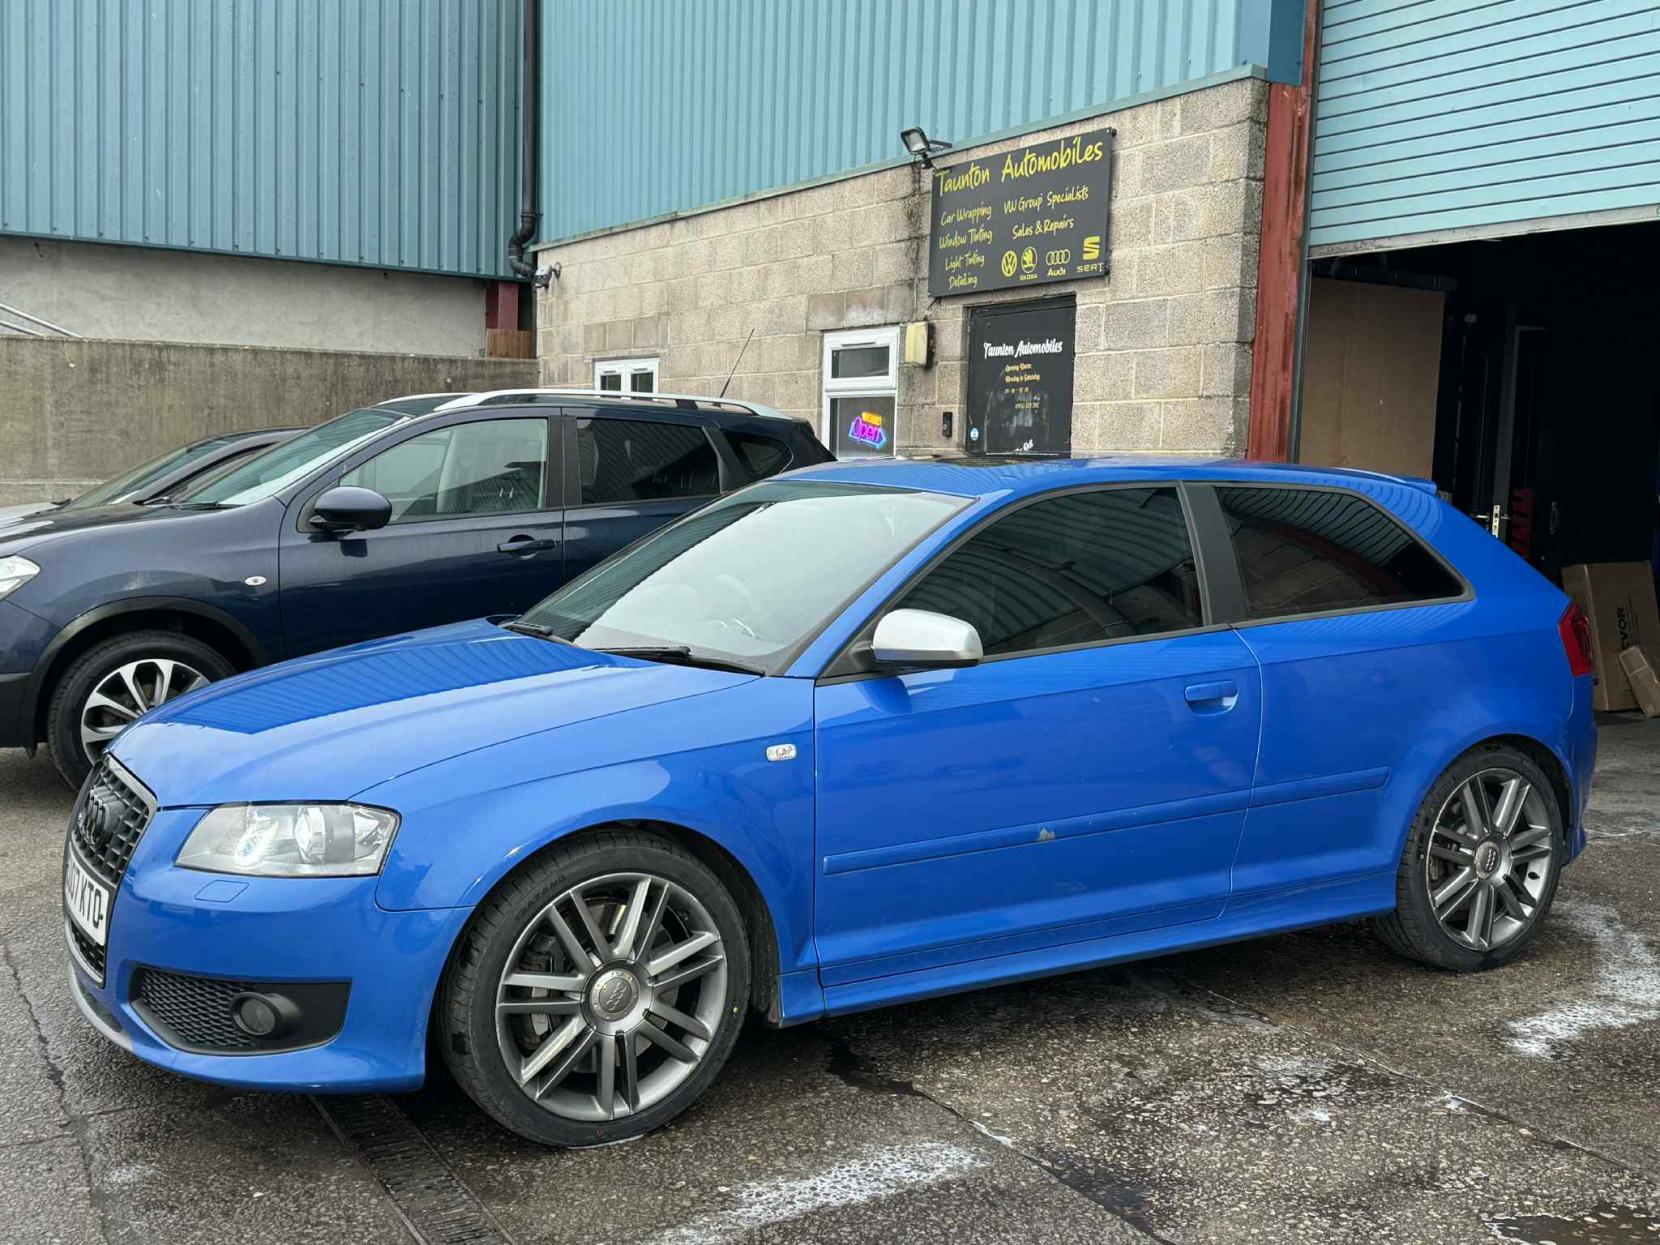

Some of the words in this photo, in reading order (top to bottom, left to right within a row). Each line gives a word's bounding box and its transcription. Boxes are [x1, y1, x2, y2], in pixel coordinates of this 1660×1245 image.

[935, 162, 990, 197] Taunton
[1001, 136, 1103, 183] Automobiles
[1018, 194, 1043, 213] Group
[1046, 184, 1089, 210] Specialists
[941, 211, 956, 226] Car
[956, 201, 992, 223] Wrapping
[939, 229, 967, 249] Window
[968, 223, 993, 245] Tinting
[1012, 223, 1033, 240] Sales
[1034, 220, 1043, 235] &
[1043, 213, 1074, 236] Repairs
[945, 255, 962, 272] Light
[963, 250, 985, 267] Tinting
[1047, 266, 1067, 277] Audi
[1076, 262, 1105, 273] SEAT
[948, 272, 978, 290] Detailing
[983, 342, 1015, 360] Taunton
[1014, 337, 1063, 358] Automobiles
[852, 415, 880, 443] Open
